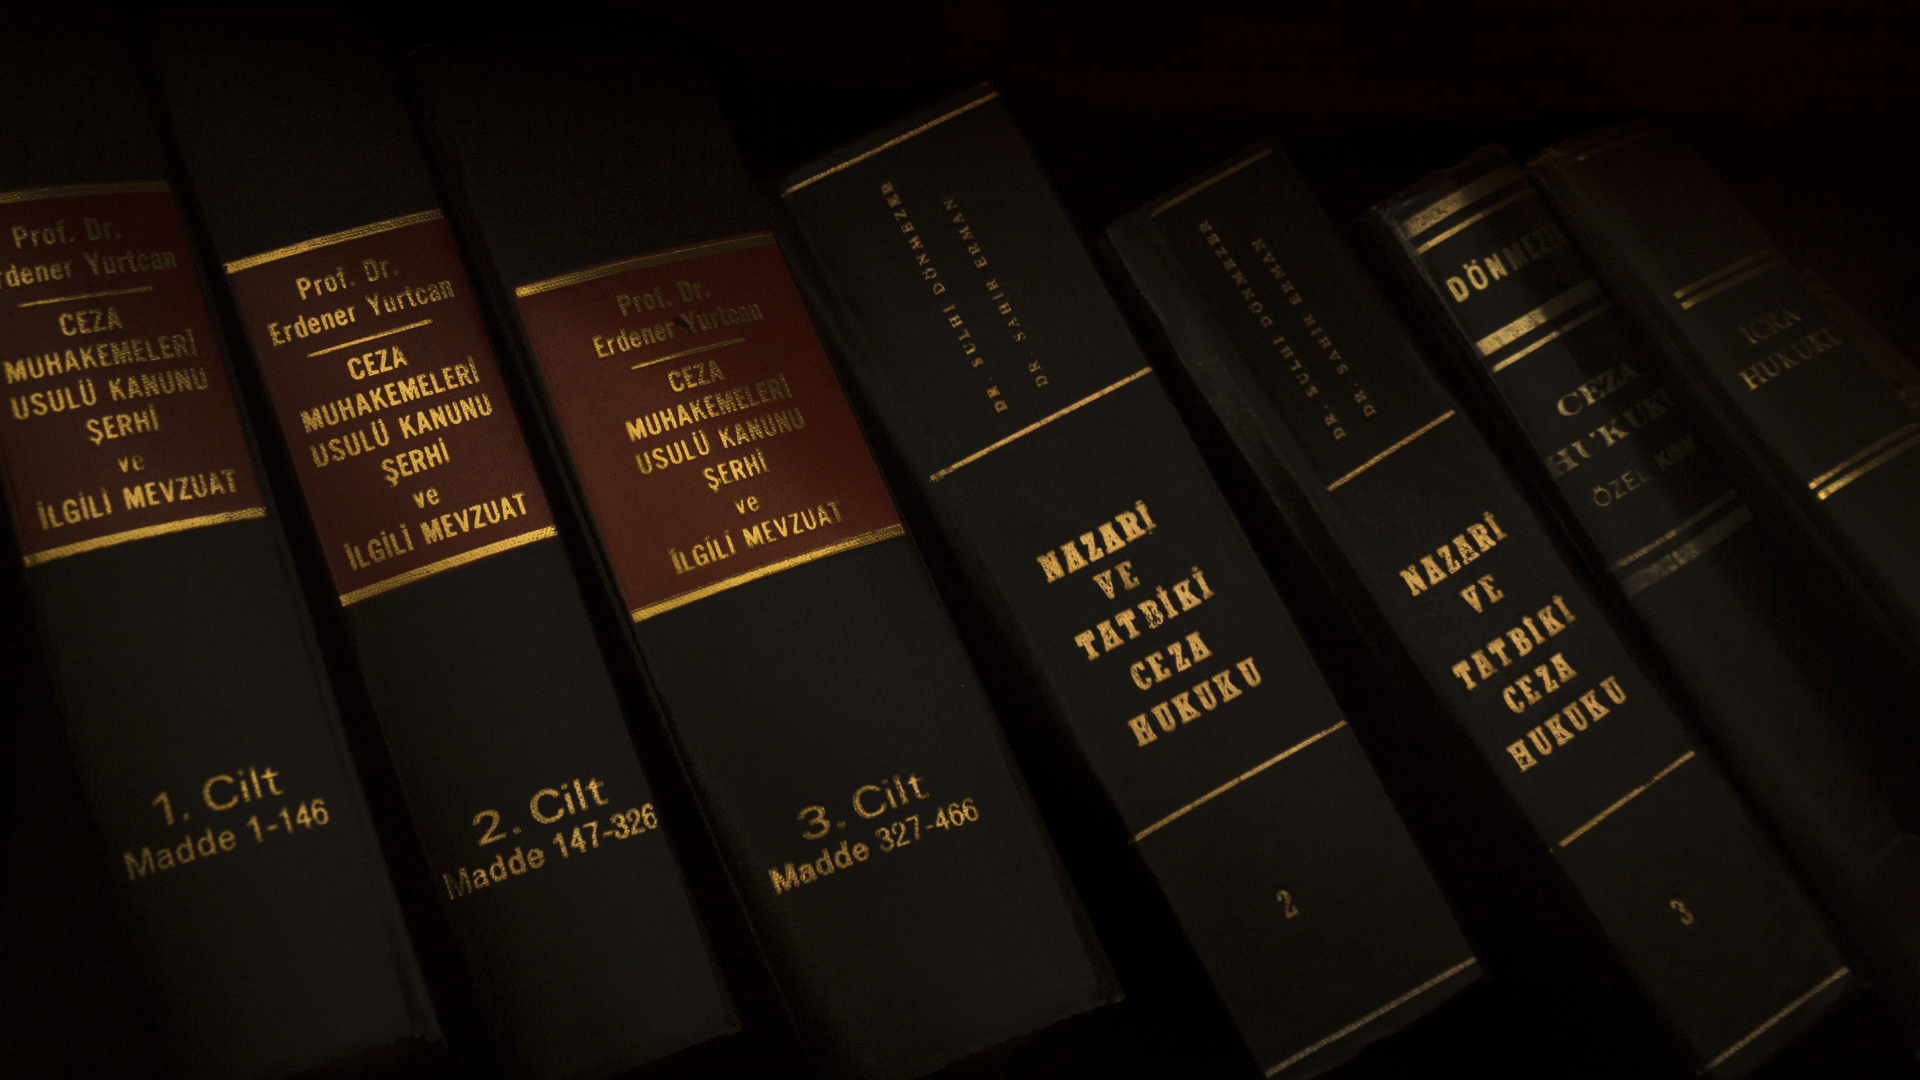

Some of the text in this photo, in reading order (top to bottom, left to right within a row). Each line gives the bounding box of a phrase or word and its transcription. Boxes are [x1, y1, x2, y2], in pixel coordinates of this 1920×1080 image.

[11, 217, 122, 249] Prof. Dr.
[943, 197, 988, 270] ERMAN
[82, 250, 178, 275] Yurtcan
[295, 258, 400, 301] Prof. Dr.
[1251, 238, 1302, 306] ERMAN
[59, 306, 123, 336] CEZA
[267, 279, 455, 347] Erdener Yurtcan
[616, 280, 711, 317] Prof. Dr.
[3, 329, 197, 385] MUHAKEMELERİ
[592, 303, 764, 359] Erdener Yurtcan
[347, 345, 408, 381] CEZA
[667, 360, 726, 392] CEZA
[1028, 351, 1050, 388] DR.
[1556, 361, 1640, 417] CEZA
[10, 366, 209, 421] USULÜ KANUNU
[300, 355, 481, 434] MUHAKEMELERİ
[624, 372, 793, 443] MUHAKEMELERİ
[986, 376, 1009, 414] DR.
[1353, 382, 1377, 418] DR.
[86, 404, 160, 446] ŞERHİ
[310, 393, 493, 469] USULÜ KANUNU
[635, 407, 806, 476] USULÜ KANUNU
[1323, 405, 1347, 441] DR.
[117, 453, 145, 474] ve
[380, 437, 450, 488] ŞERHİ
[702, 447, 770, 495] ŞERHİ
[1592, 468, 1651, 507] ÖZEL
[37, 469, 237, 531] İLGİLİ MEVZUAT
[412, 486, 440, 509] ve
[734, 495, 760, 516] ve
[343, 491, 528, 572] İLGİLİ MEVZUAT
[667, 500, 843, 575] İLGİLİ MEVZUAT
[1036, 499, 1157, 584] NAZARİ
[1399, 510, 1508, 597] NAZARİ
[1092, 559, 1141, 600] VE
[1459, 573, 1505, 614] VE
[1074, 565, 1215, 662] TATBİKİ
[1129, 630, 1213, 691] CEZA
[1451, 594, 1577, 691] TATBİKİ
[1127, 656, 1262, 747] HUKUKU
[1502, 652, 1578, 714] CEZA
[1506, 675, 1627, 773] HUKUKU
[151, 766, 284, 827] 1. Cilt
[472, 776, 610, 847] 2. Cilt
[797, 772, 930, 841] 3. Cilt
[123, 797, 330, 880] Madde 1-146
[442, 802, 659, 901] Madde 147-326
[767, 797, 980, 896] Madde 327-466
[1276, 889, 1299, 920] 2
[1669, 897, 1695, 926] 3
